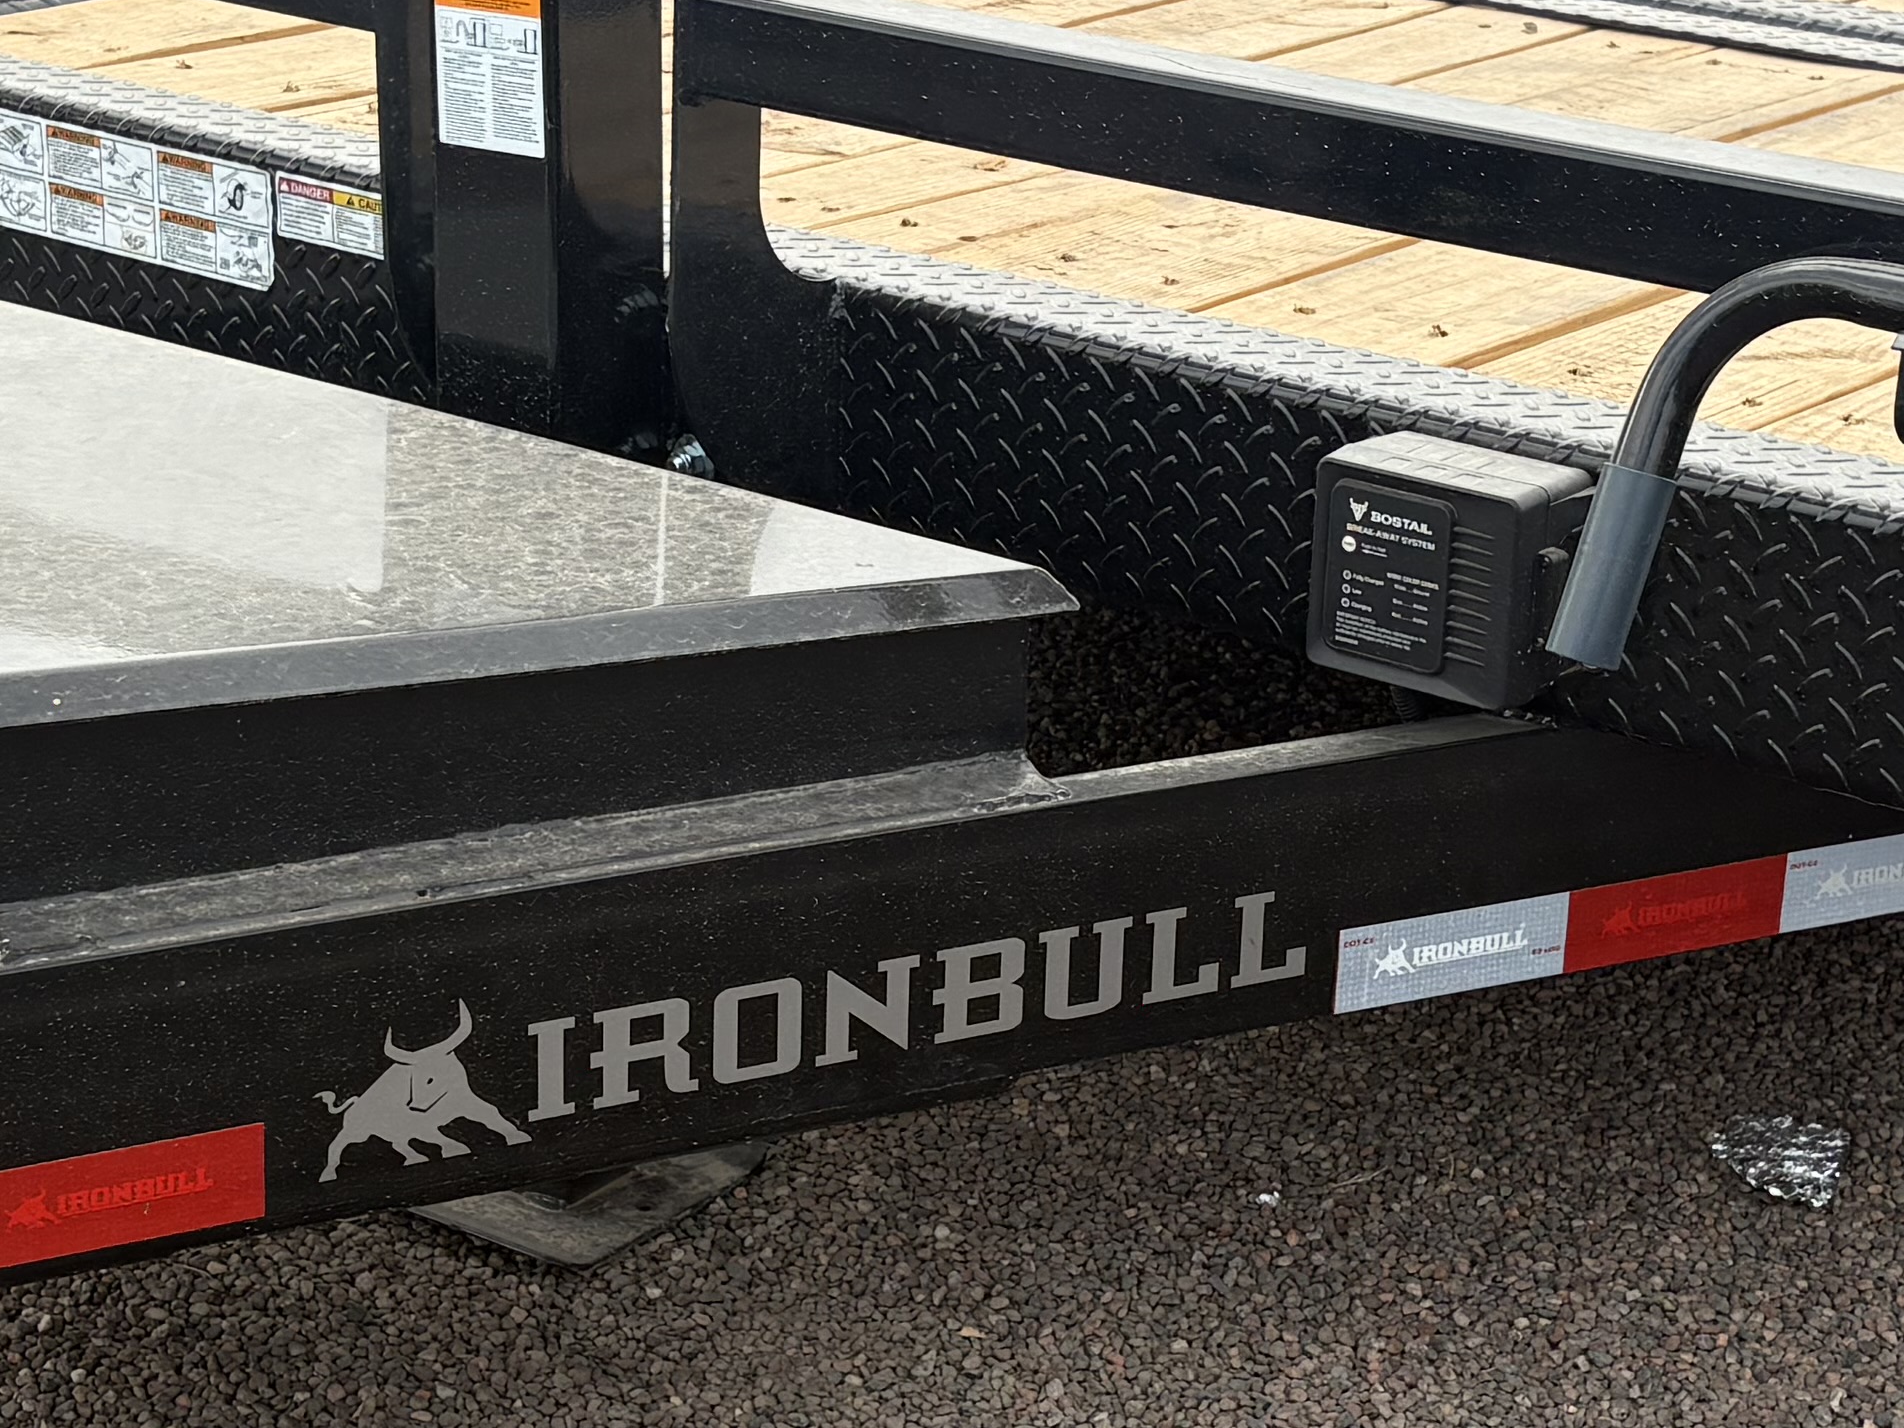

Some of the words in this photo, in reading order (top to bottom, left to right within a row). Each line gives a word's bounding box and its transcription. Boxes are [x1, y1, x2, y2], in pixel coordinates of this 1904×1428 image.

[291, 180, 331, 201] DANGER
[358, 198, 382, 213] CAUT
[1371, 511, 1433, 536] BOSTAIL
[1637, 891, 1748, 928] IRONBULL
[1412, 922, 1529, 965] IRONBULL
[527, 890, 1307, 1123] IRONBULL
[56, 1168, 215, 1216] IRONBULL
